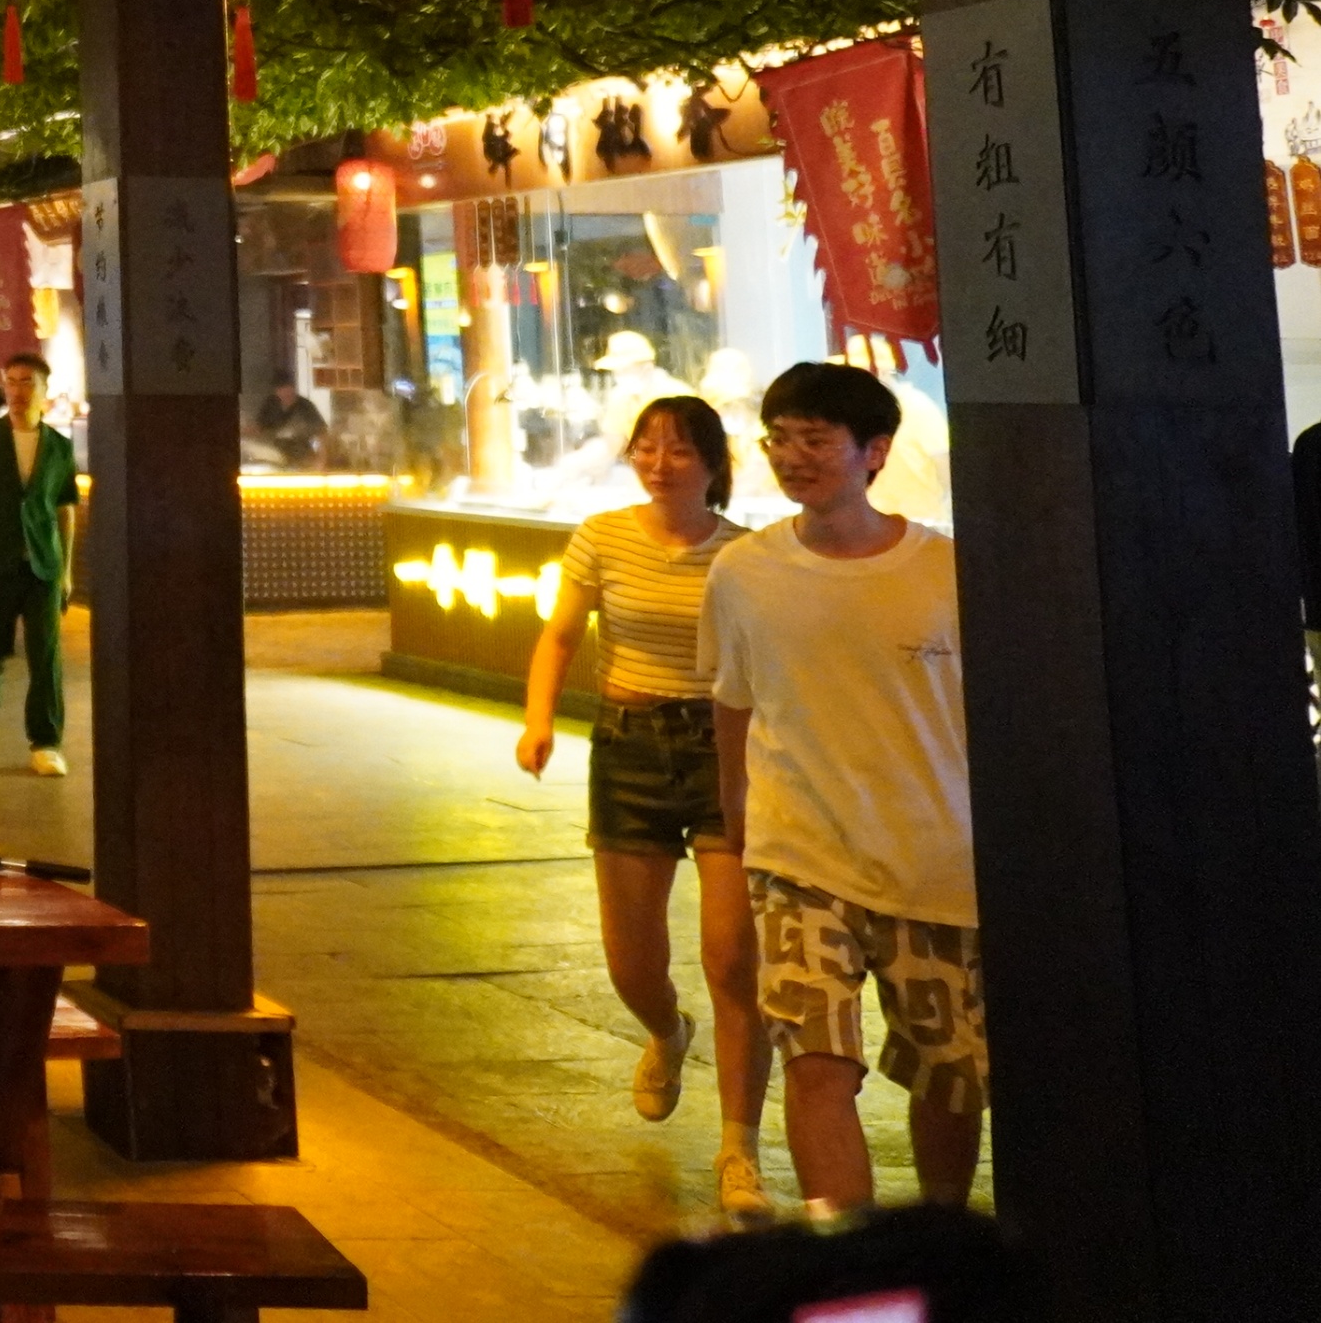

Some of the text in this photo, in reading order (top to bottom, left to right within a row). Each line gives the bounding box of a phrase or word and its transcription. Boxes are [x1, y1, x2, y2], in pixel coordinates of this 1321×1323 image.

[968, 40, 1028, 363] 有粗有细
[1135, 30, 1217, 365] 五颜六色
